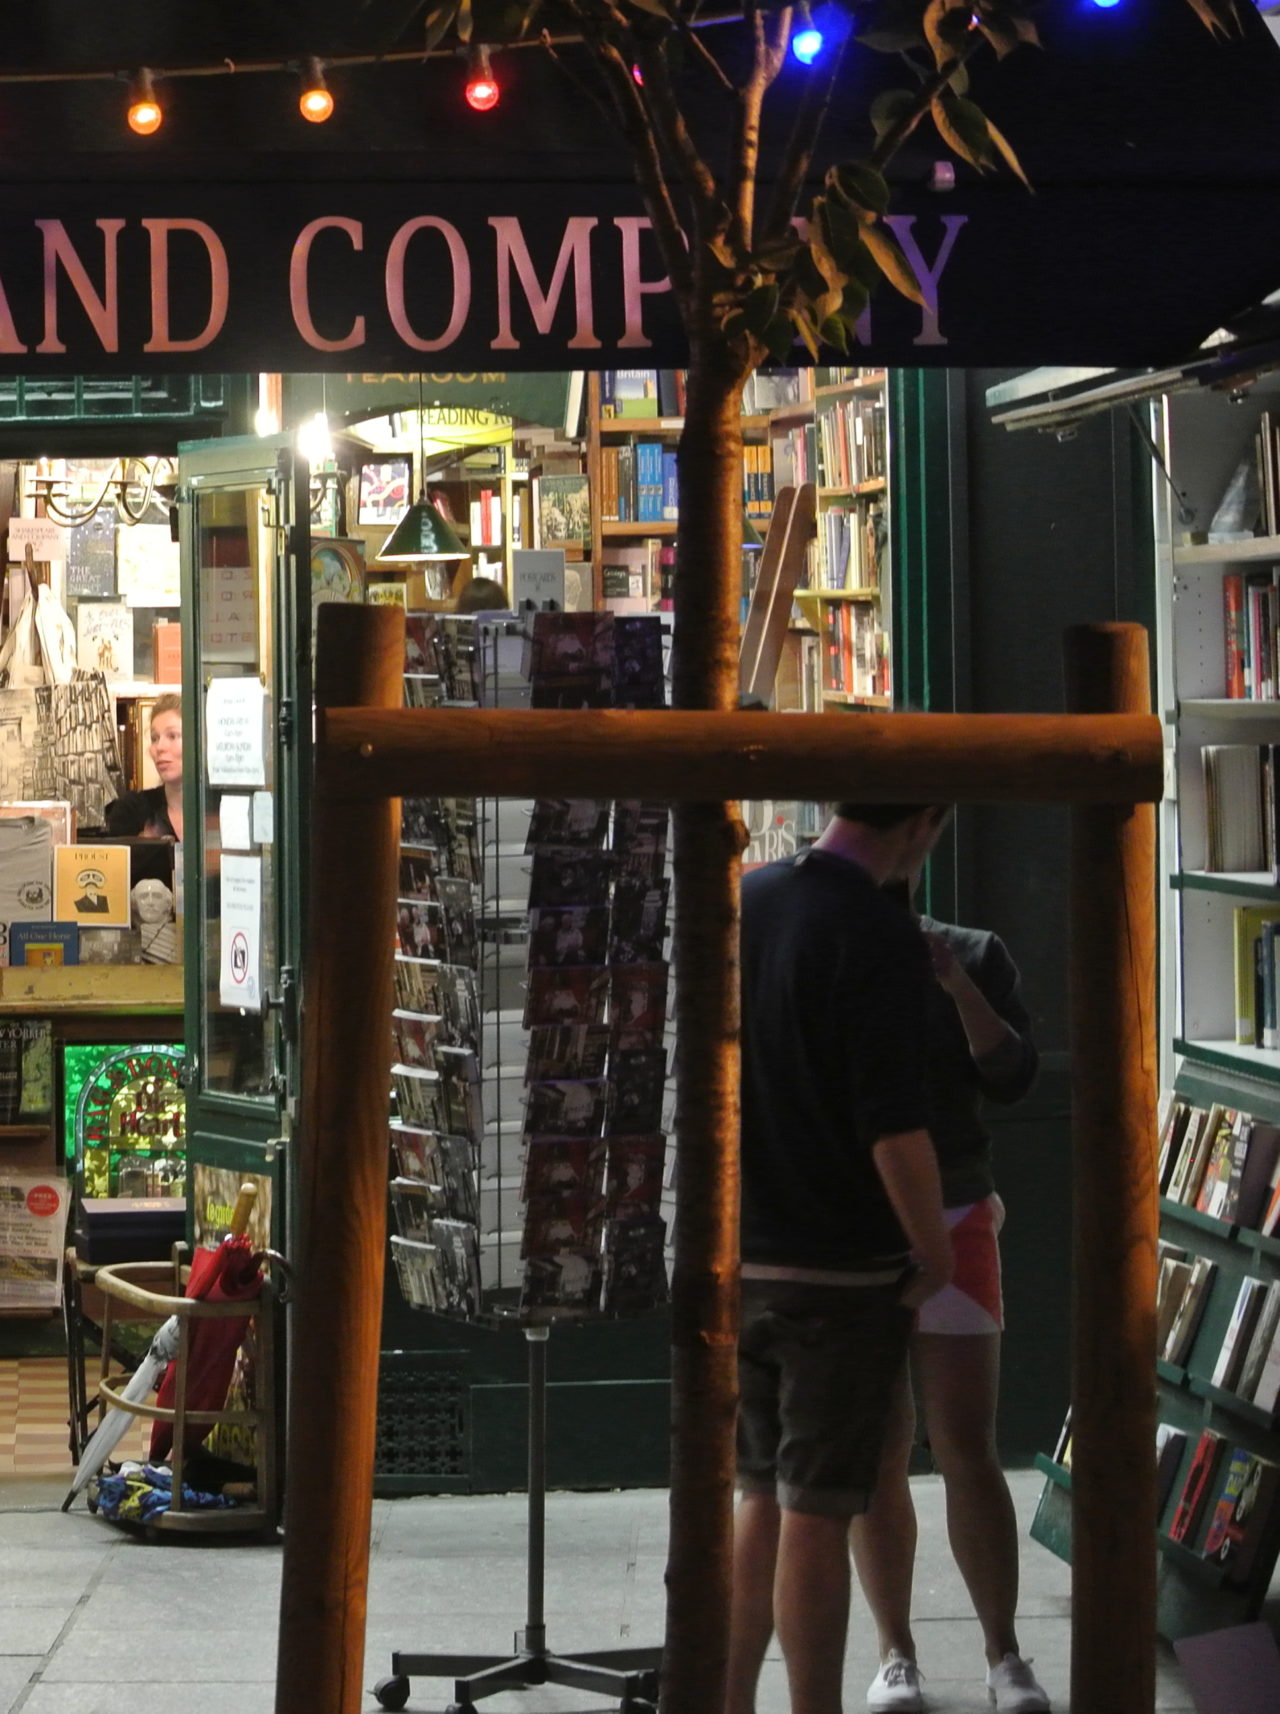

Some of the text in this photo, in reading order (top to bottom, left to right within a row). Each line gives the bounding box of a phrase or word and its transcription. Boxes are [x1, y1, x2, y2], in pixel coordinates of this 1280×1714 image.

[289, 215, 969, 352] COMPY
[416, 408, 488, 425] READING
[8, 1028, 52, 1040] YORKER
